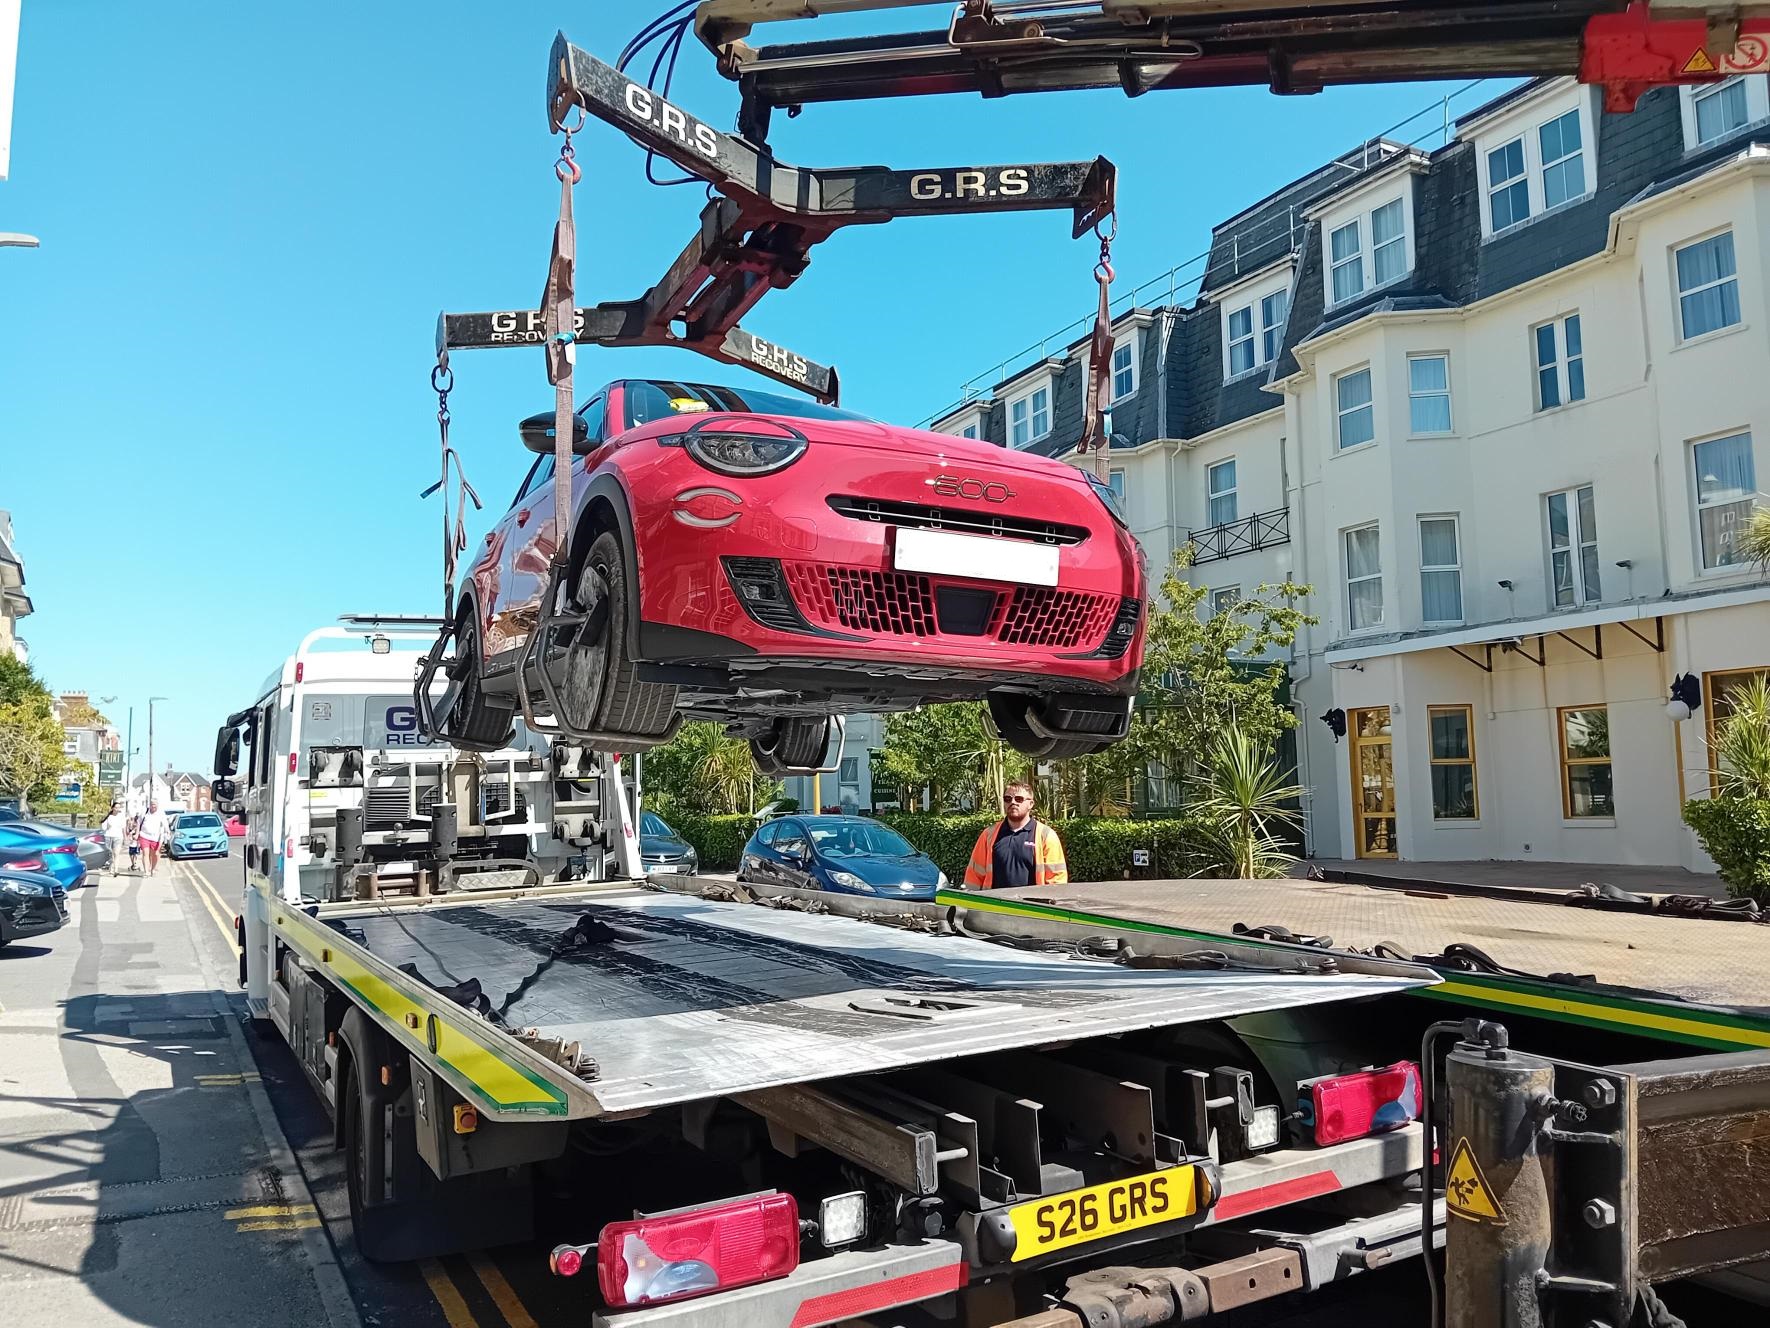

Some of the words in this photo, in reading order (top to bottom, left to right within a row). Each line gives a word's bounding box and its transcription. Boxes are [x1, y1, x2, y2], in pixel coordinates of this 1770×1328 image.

[625, 83, 717, 158] G.R.S
[910, 169, 1029, 200] G.R.S
[491, 328, 585, 343] RECOVY
[751, 334, 808, 375] G.R.S
[751, 351, 808, 383] RECOVERY
[1037, 1193, 1099, 1244] S26
[1108, 1176, 1169, 1225] GRS
